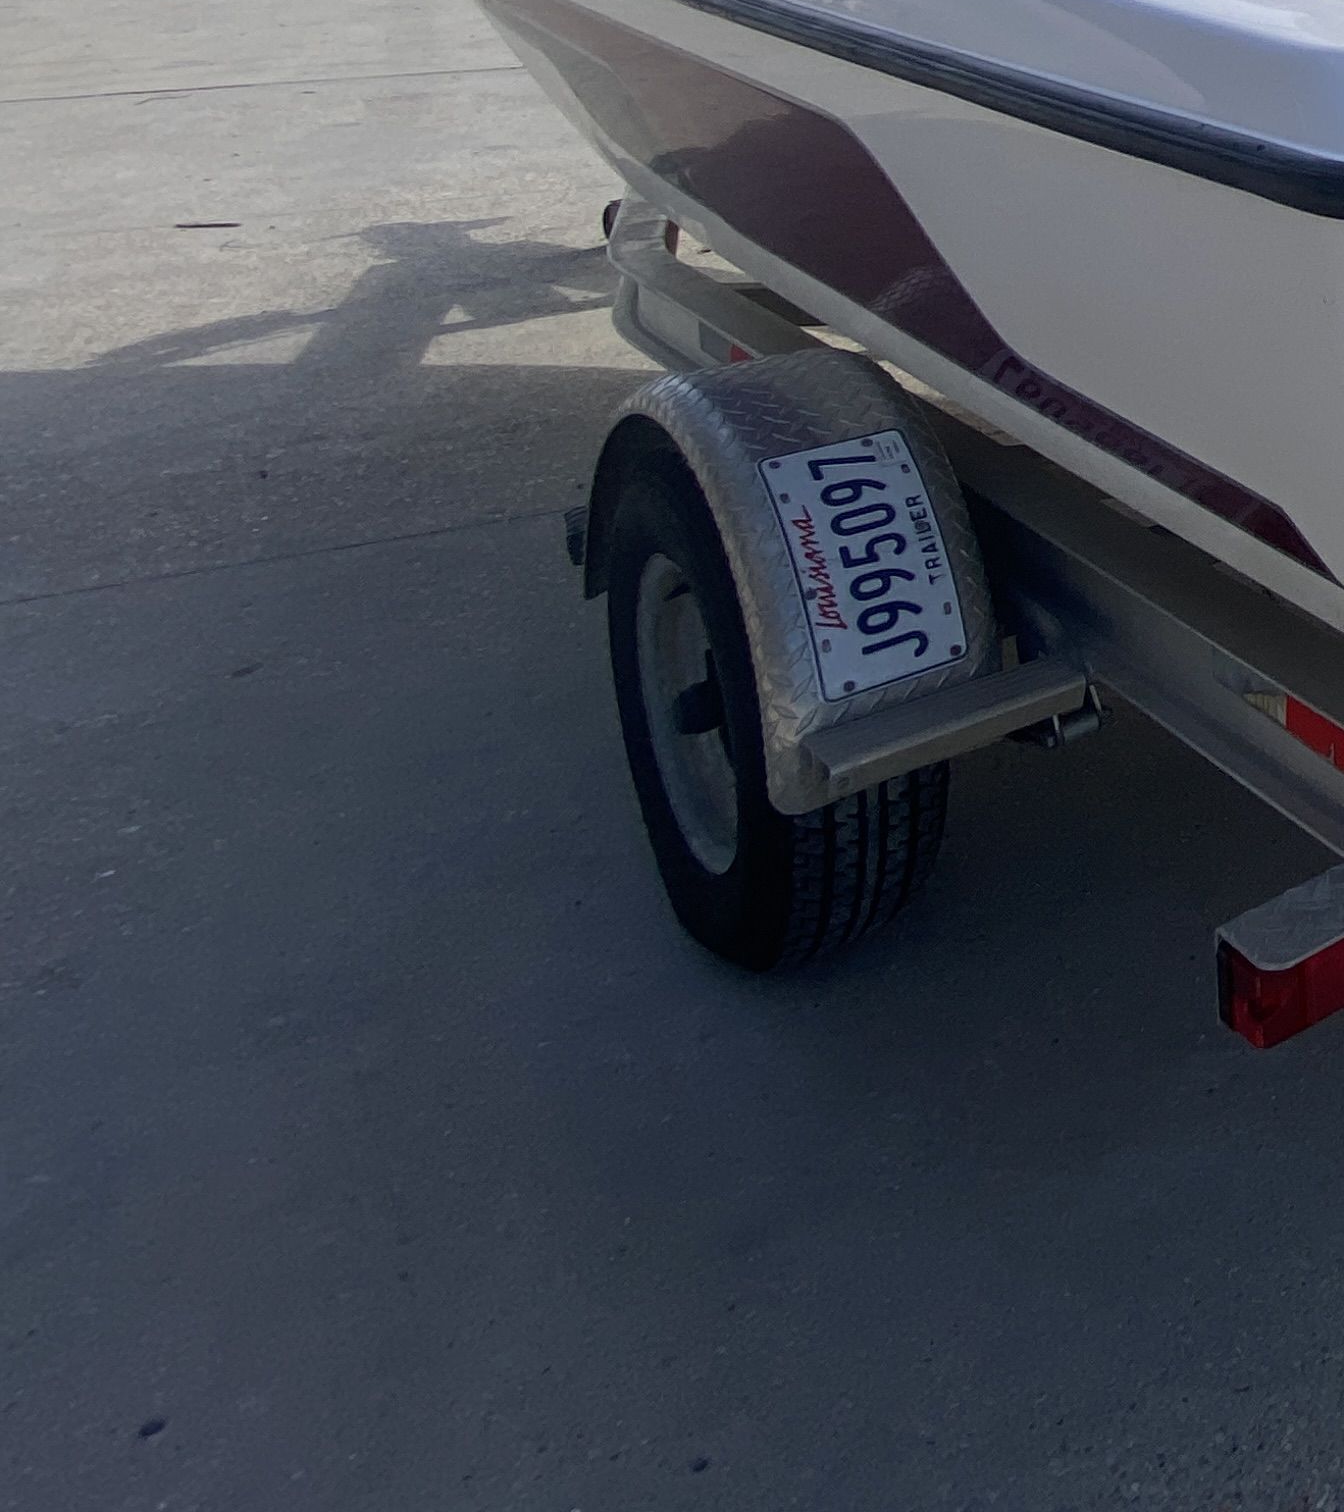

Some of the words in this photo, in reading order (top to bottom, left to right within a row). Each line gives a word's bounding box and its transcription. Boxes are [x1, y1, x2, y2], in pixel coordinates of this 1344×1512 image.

[792, 504, 848, 631] Louisiana
[808, 454, 930, 659] J995097
[905, 493, 946, 586] TRAILER
